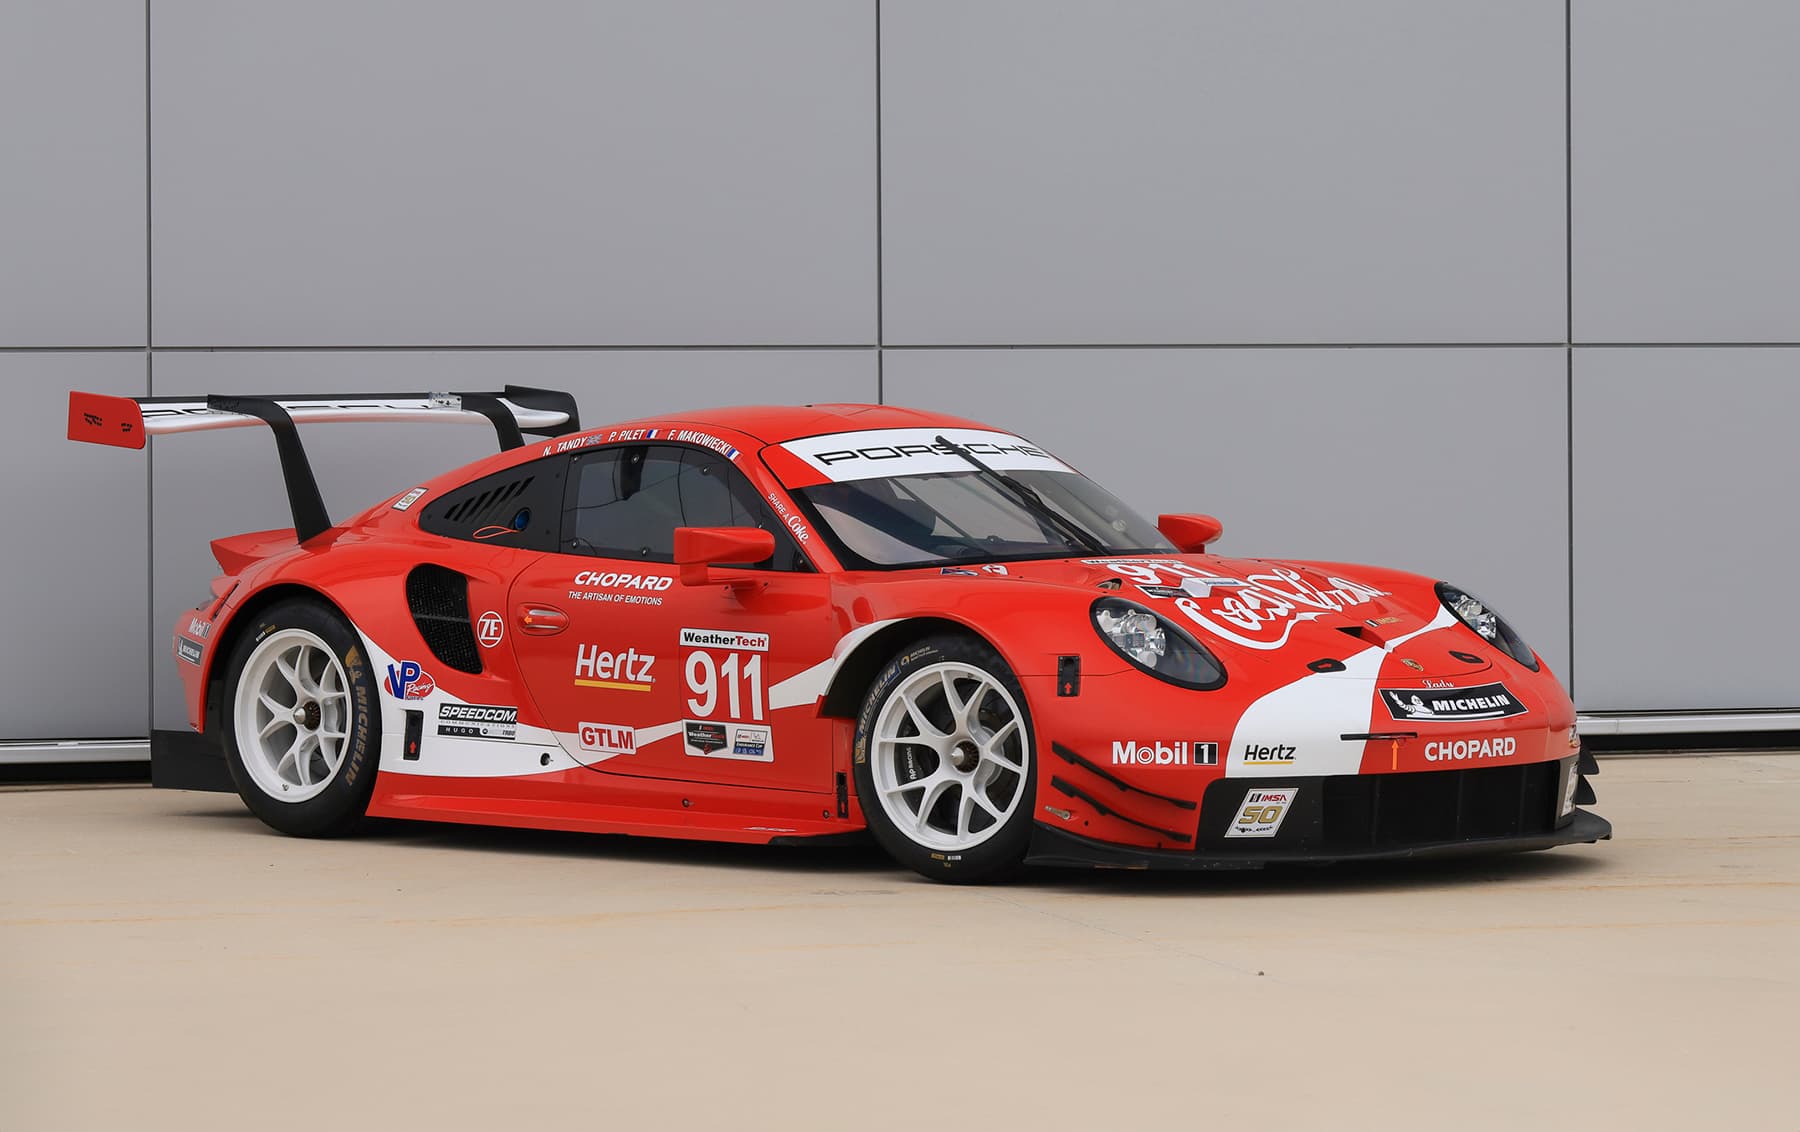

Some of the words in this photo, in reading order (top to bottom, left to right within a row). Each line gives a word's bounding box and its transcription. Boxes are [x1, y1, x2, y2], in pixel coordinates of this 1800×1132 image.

[608, 431, 615, 442] P.
[618, 429, 646, 440] PILET
[667, 429, 676, 441] F.
[677, 429, 732, 454] MAKOWIECKI
[543, 446, 552, 457] N.
[557, 436, 587, 453] TANDY
[768, 493, 786, 514] SHARE
[788, 516, 809, 542] Coke
[574, 571, 673, 591] CHOPARD
[1107, 563, 1221, 585] 911
[568, 591, 582, 600] THE
[582, 593, 613, 602] ARTISAN
[625, 595, 663, 606] EMOTIONS
[683, 632, 766, 648] WeatherTech
[387, 661, 420, 699] VP
[685, 651, 763, 720] 911
[1422, 679, 1454, 689] Lady
[1432, 694, 1510, 712] MICHELIN
[345, 686, 368, 785] MICHELIN
[581, 726, 634, 750] GTLM
[1112, 741, 1188, 765] Mobil
[1243, 744, 1297, 761] Hertz
[1424, 737, 1516, 762] CHOPARD
[1238, 805, 1284, 824] 50
